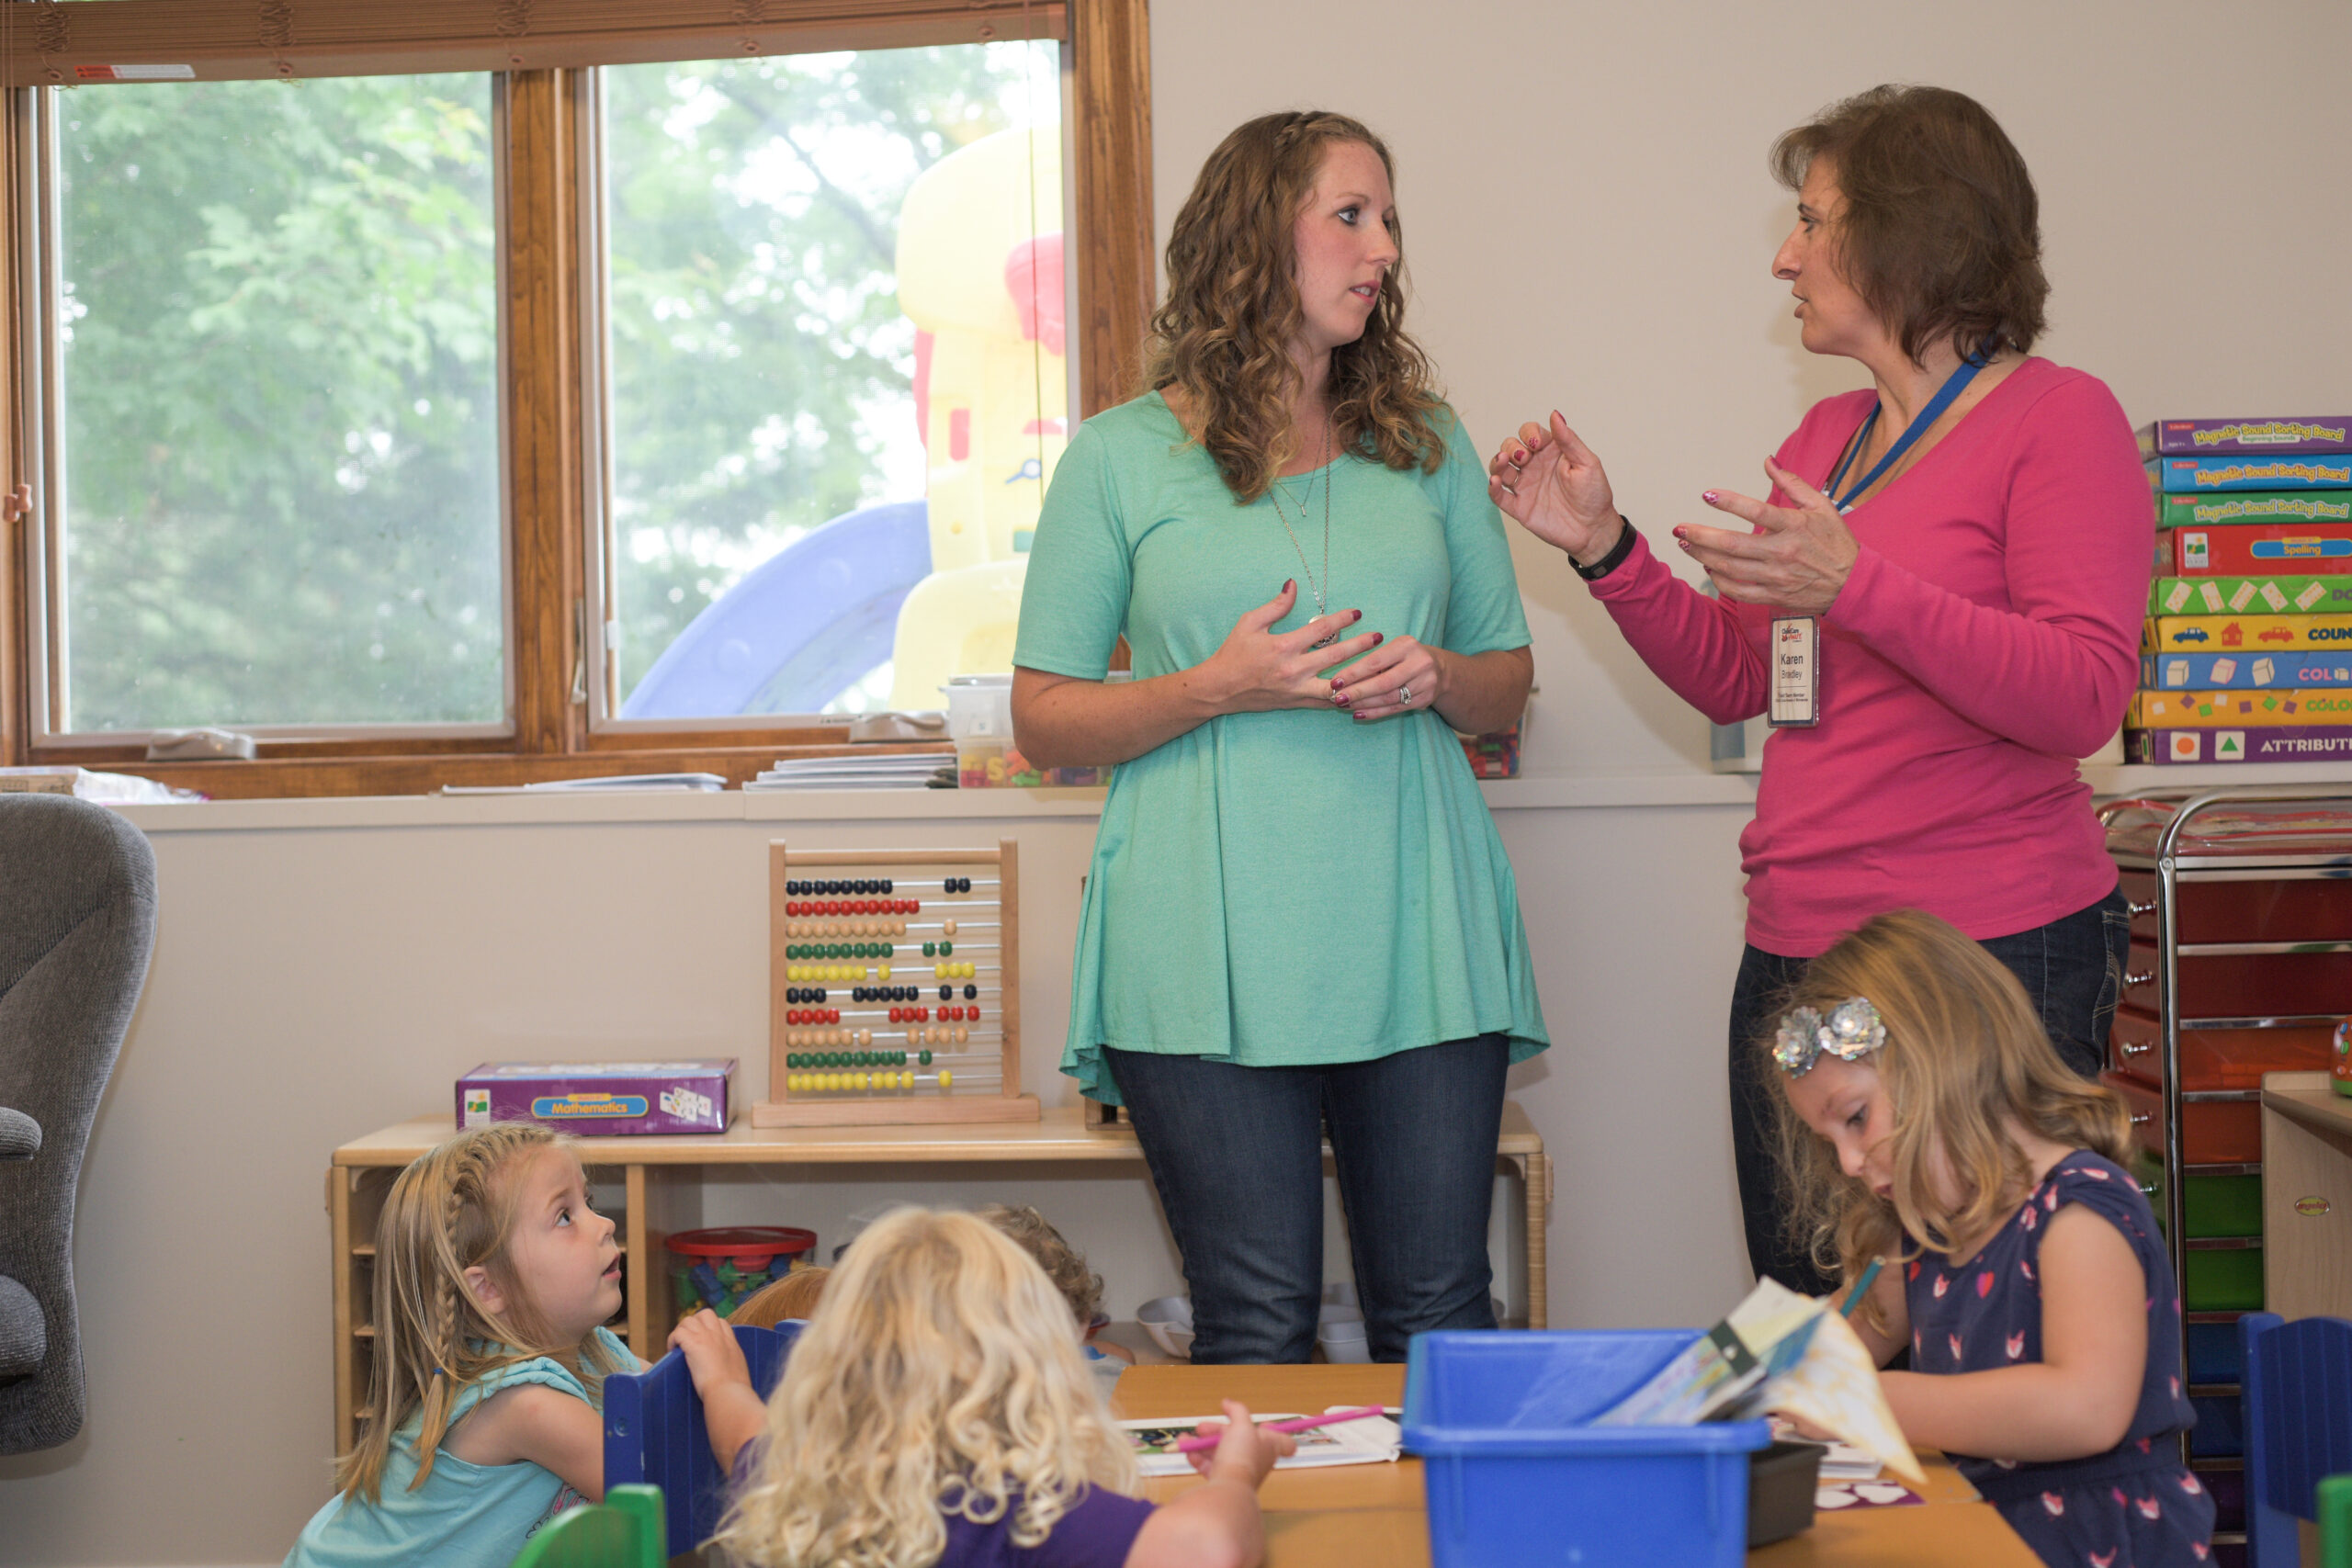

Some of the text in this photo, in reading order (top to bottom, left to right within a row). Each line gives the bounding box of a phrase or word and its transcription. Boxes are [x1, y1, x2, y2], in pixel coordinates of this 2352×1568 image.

[2194, 422, 2346, 446] Magnetic Sound Sorting Board
[2195, 461, 2350, 486] Magnetic Sound Sorting Board
[2194, 498, 2349, 522] Magnetic Sound Sorting Board
[2284, 544, 2322, 557] Spelling
[1781, 654, 1804, 665] Karen
[1781, 671, 1802, 681] Bradley
[551, 1101, 628, 1114] Mathematics
